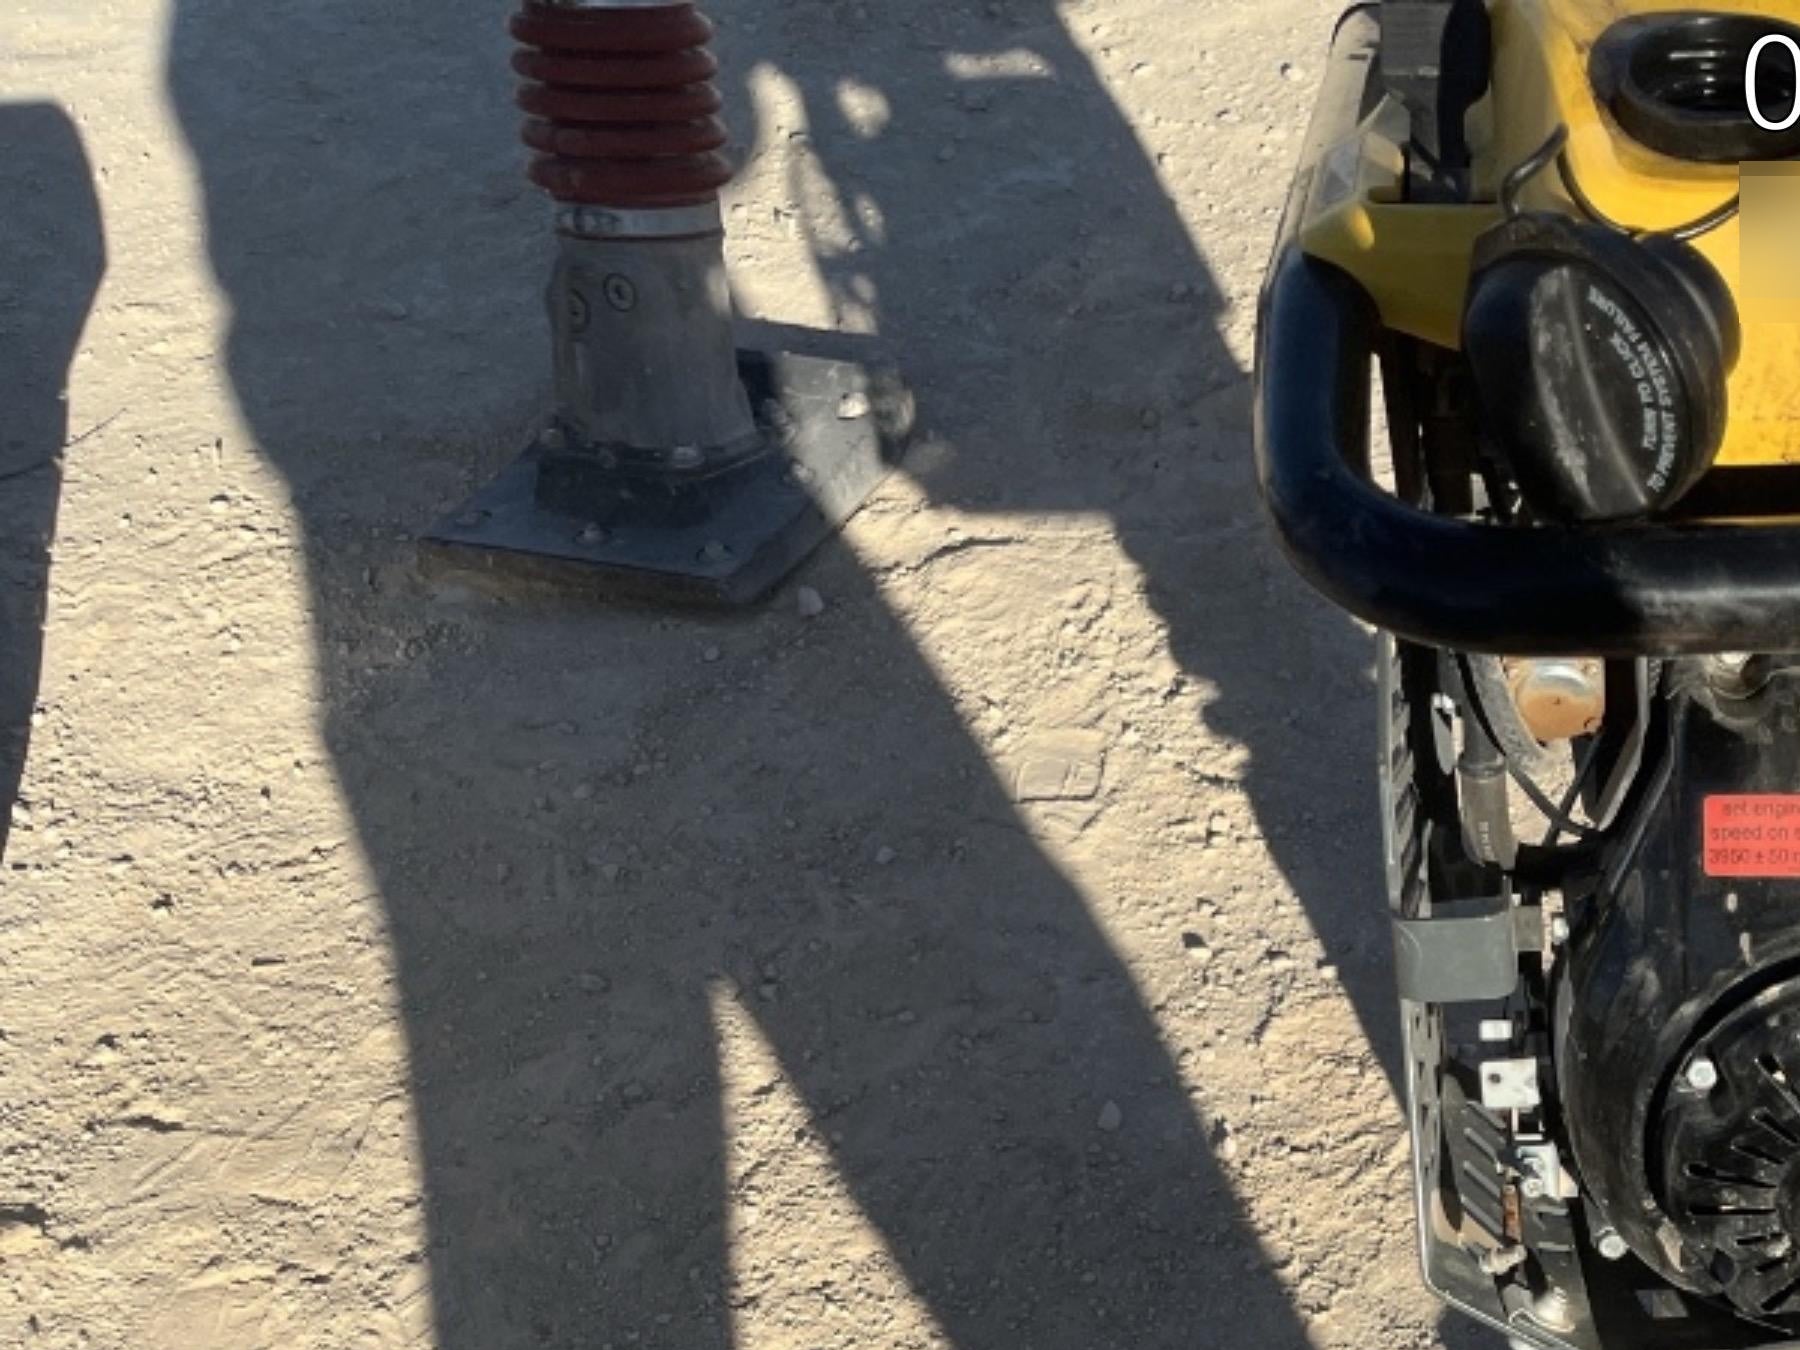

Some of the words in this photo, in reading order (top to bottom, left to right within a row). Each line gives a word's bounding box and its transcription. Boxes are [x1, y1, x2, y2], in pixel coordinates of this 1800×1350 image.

[1721, 800, 1749, 816] set
[1711, 825, 1762, 842] speed
[1766, 827, 1789, 841] on
[1769, 848, 1789, 865] 50
